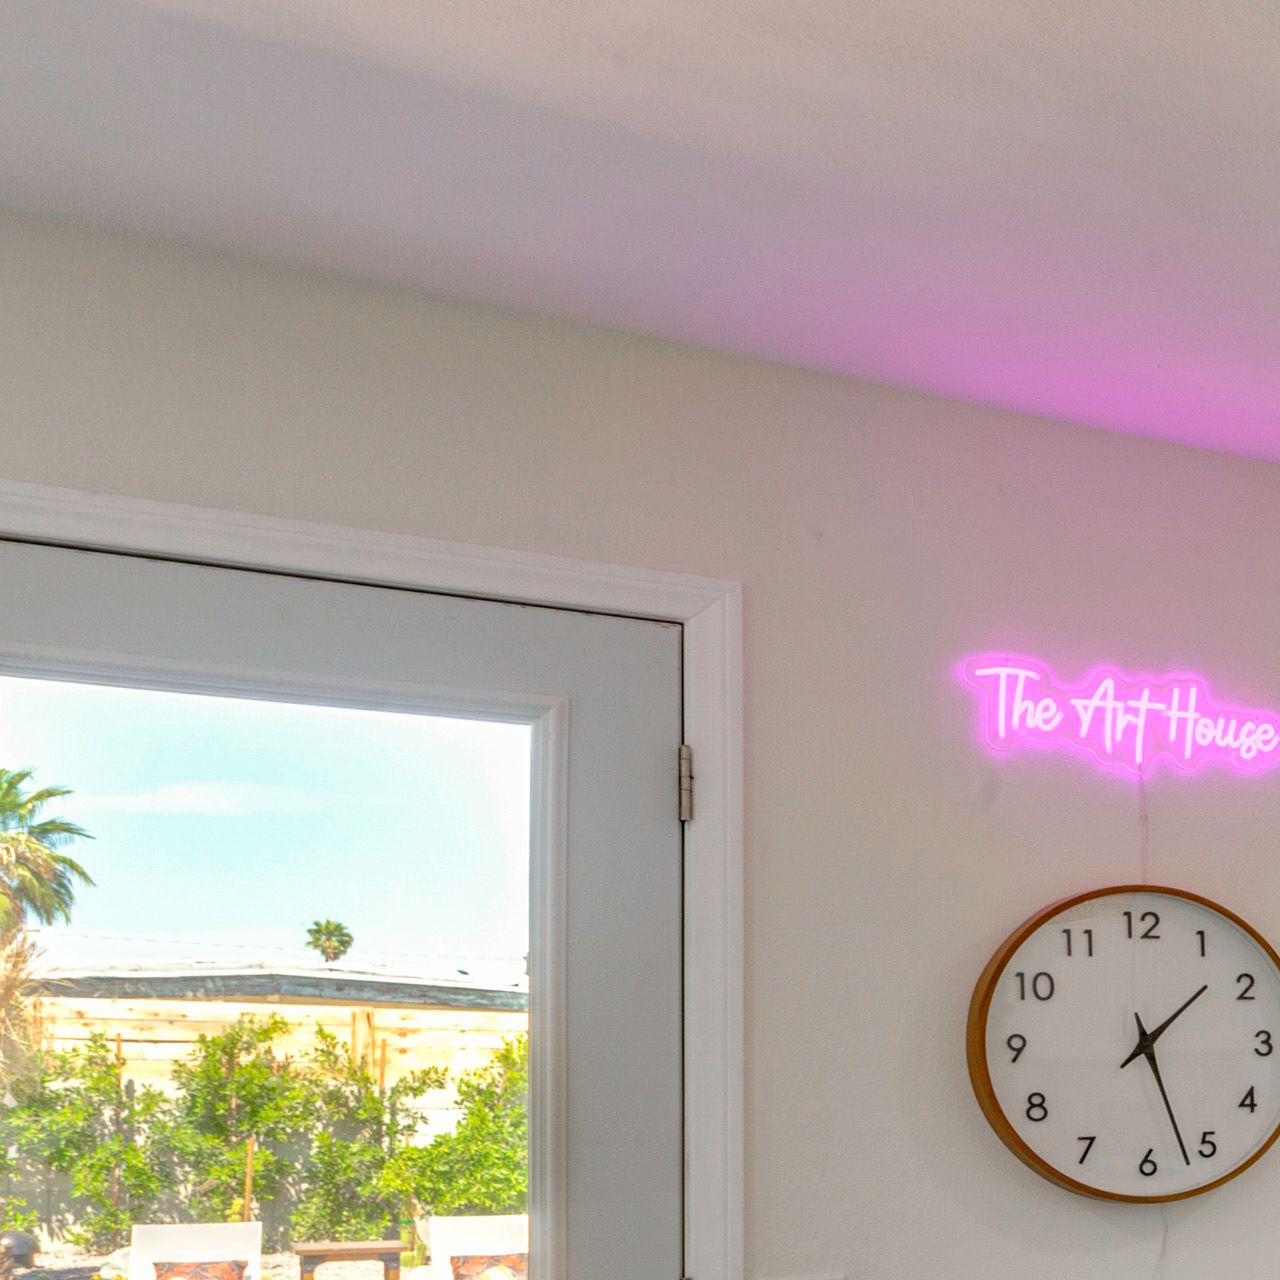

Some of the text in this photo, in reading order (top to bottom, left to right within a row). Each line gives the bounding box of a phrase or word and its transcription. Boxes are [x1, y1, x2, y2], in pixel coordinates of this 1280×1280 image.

[974, 667, 1280, 764] The Art House
[1123, 911, 1160, 939] 12
[1062, 929, 1092, 956] 11
[1196, 930, 1205, 957] 1
[1015, 972, 1054, 1001] 10
[1237, 973, 1255, 1000] 2
[1007, 1034, 1026, 1063] 9
[1254, 1030, 1273, 1056] 3
[1026, 1092, 1048, 1122] 8
[1238, 1086, 1257, 1113] 4
[1078, 1136, 1096, 1164] 7
[1198, 1131, 1216, 1158] 5
[1139, 1149, 1157, 1176] 6
